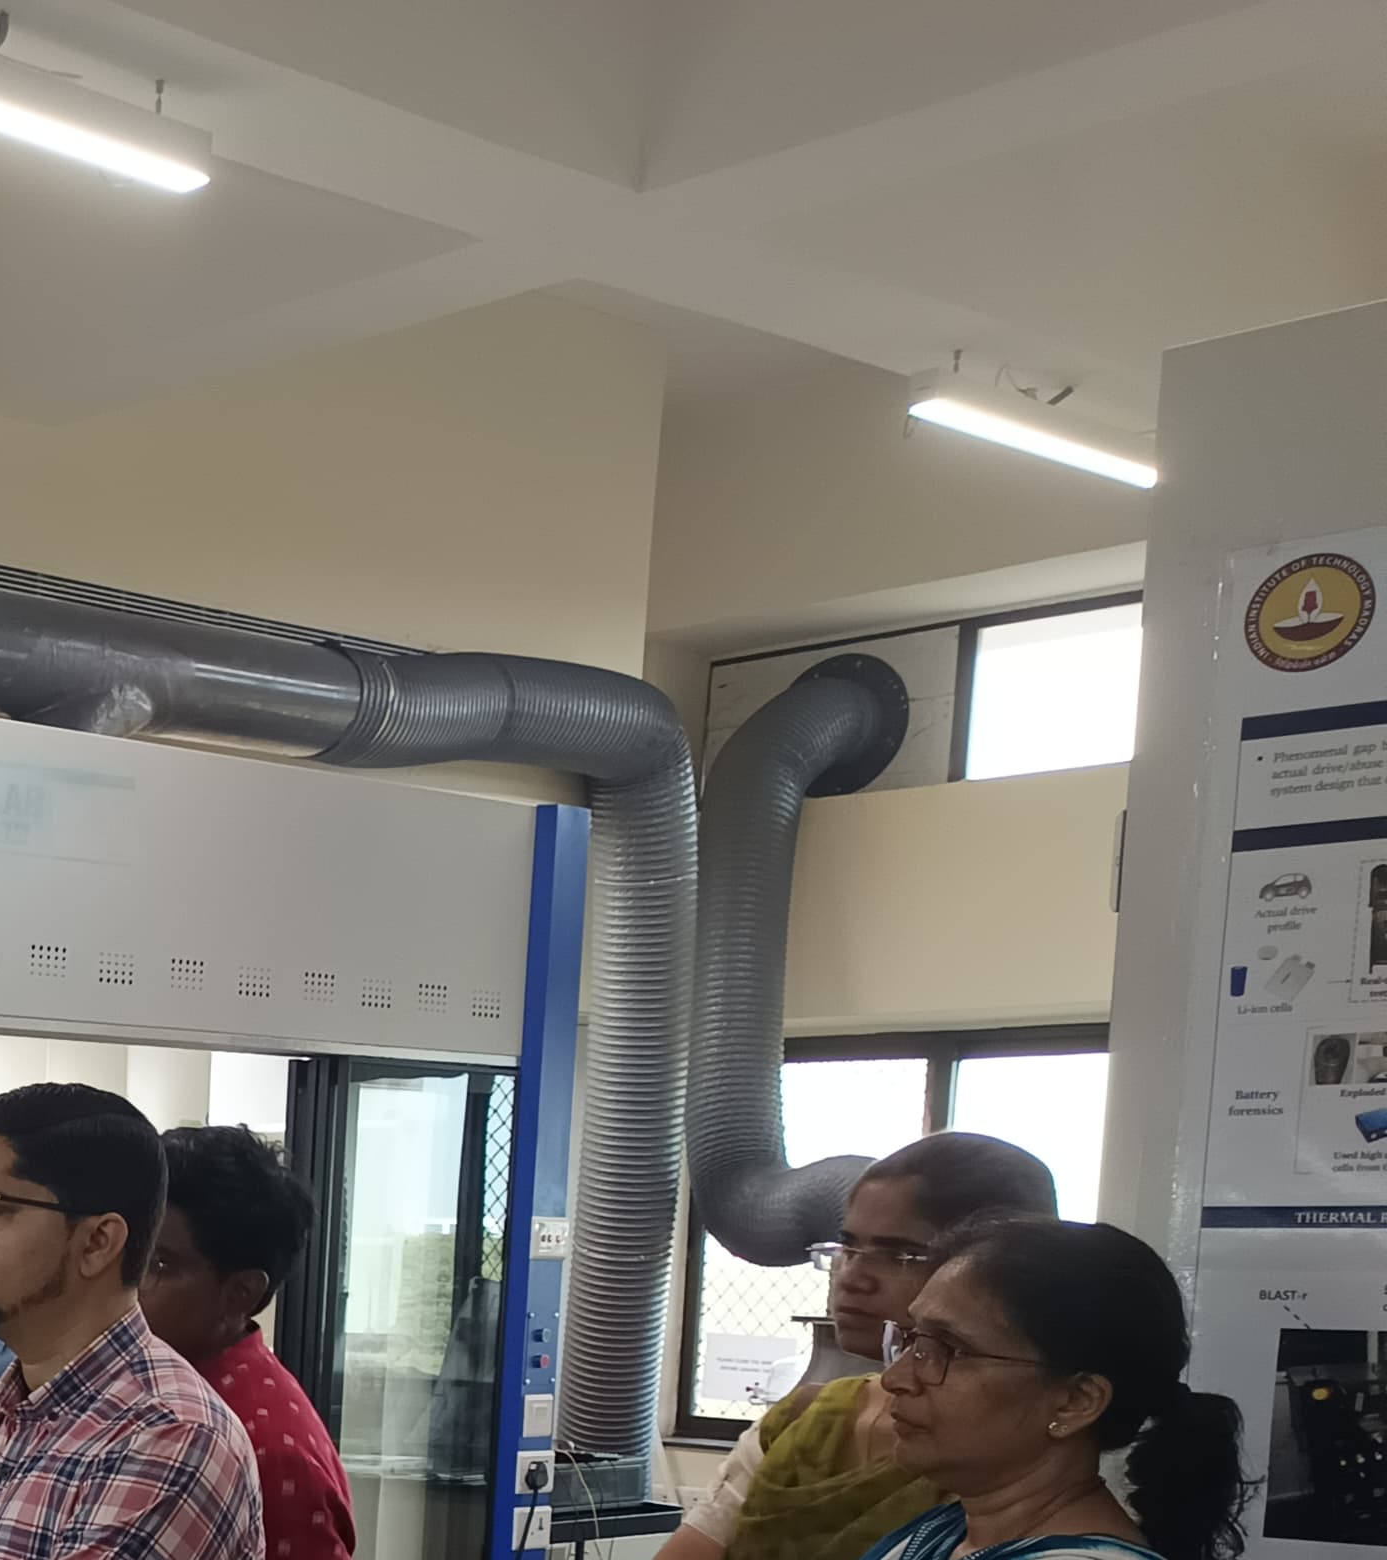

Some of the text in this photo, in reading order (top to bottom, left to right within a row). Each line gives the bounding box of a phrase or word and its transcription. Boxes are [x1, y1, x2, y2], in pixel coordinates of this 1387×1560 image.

[1246, 555, 1374, 660] INDIAN INSTITUTE OF TECHNOLOGY MADRAS
[1274, 744, 1348, 763] Phenomenal
[1353, 742, 1377, 757] gap
[1271, 758, 1385, 780] actual drive/abuse
[1270, 775, 1382, 799] system design that
[1255, 906, 1318, 919] Actual drive
[1267, 920, 1302, 934] profile
[1237, 1002, 1294, 1016] Li-ion cells
[1235, 1089, 1279, 1102] Battery
[1339, 1087, 1387, 1100] Exploded
[1228, 1104, 1284, 1117] forensics
[1333, 1149, 1383, 1161] Used high
[1331, 1163, 1381, 1172] cells from
[1294, 1211, 1378, 1225] THERMAL
[1258, 1289, 1309, 1302] BLAST-r
